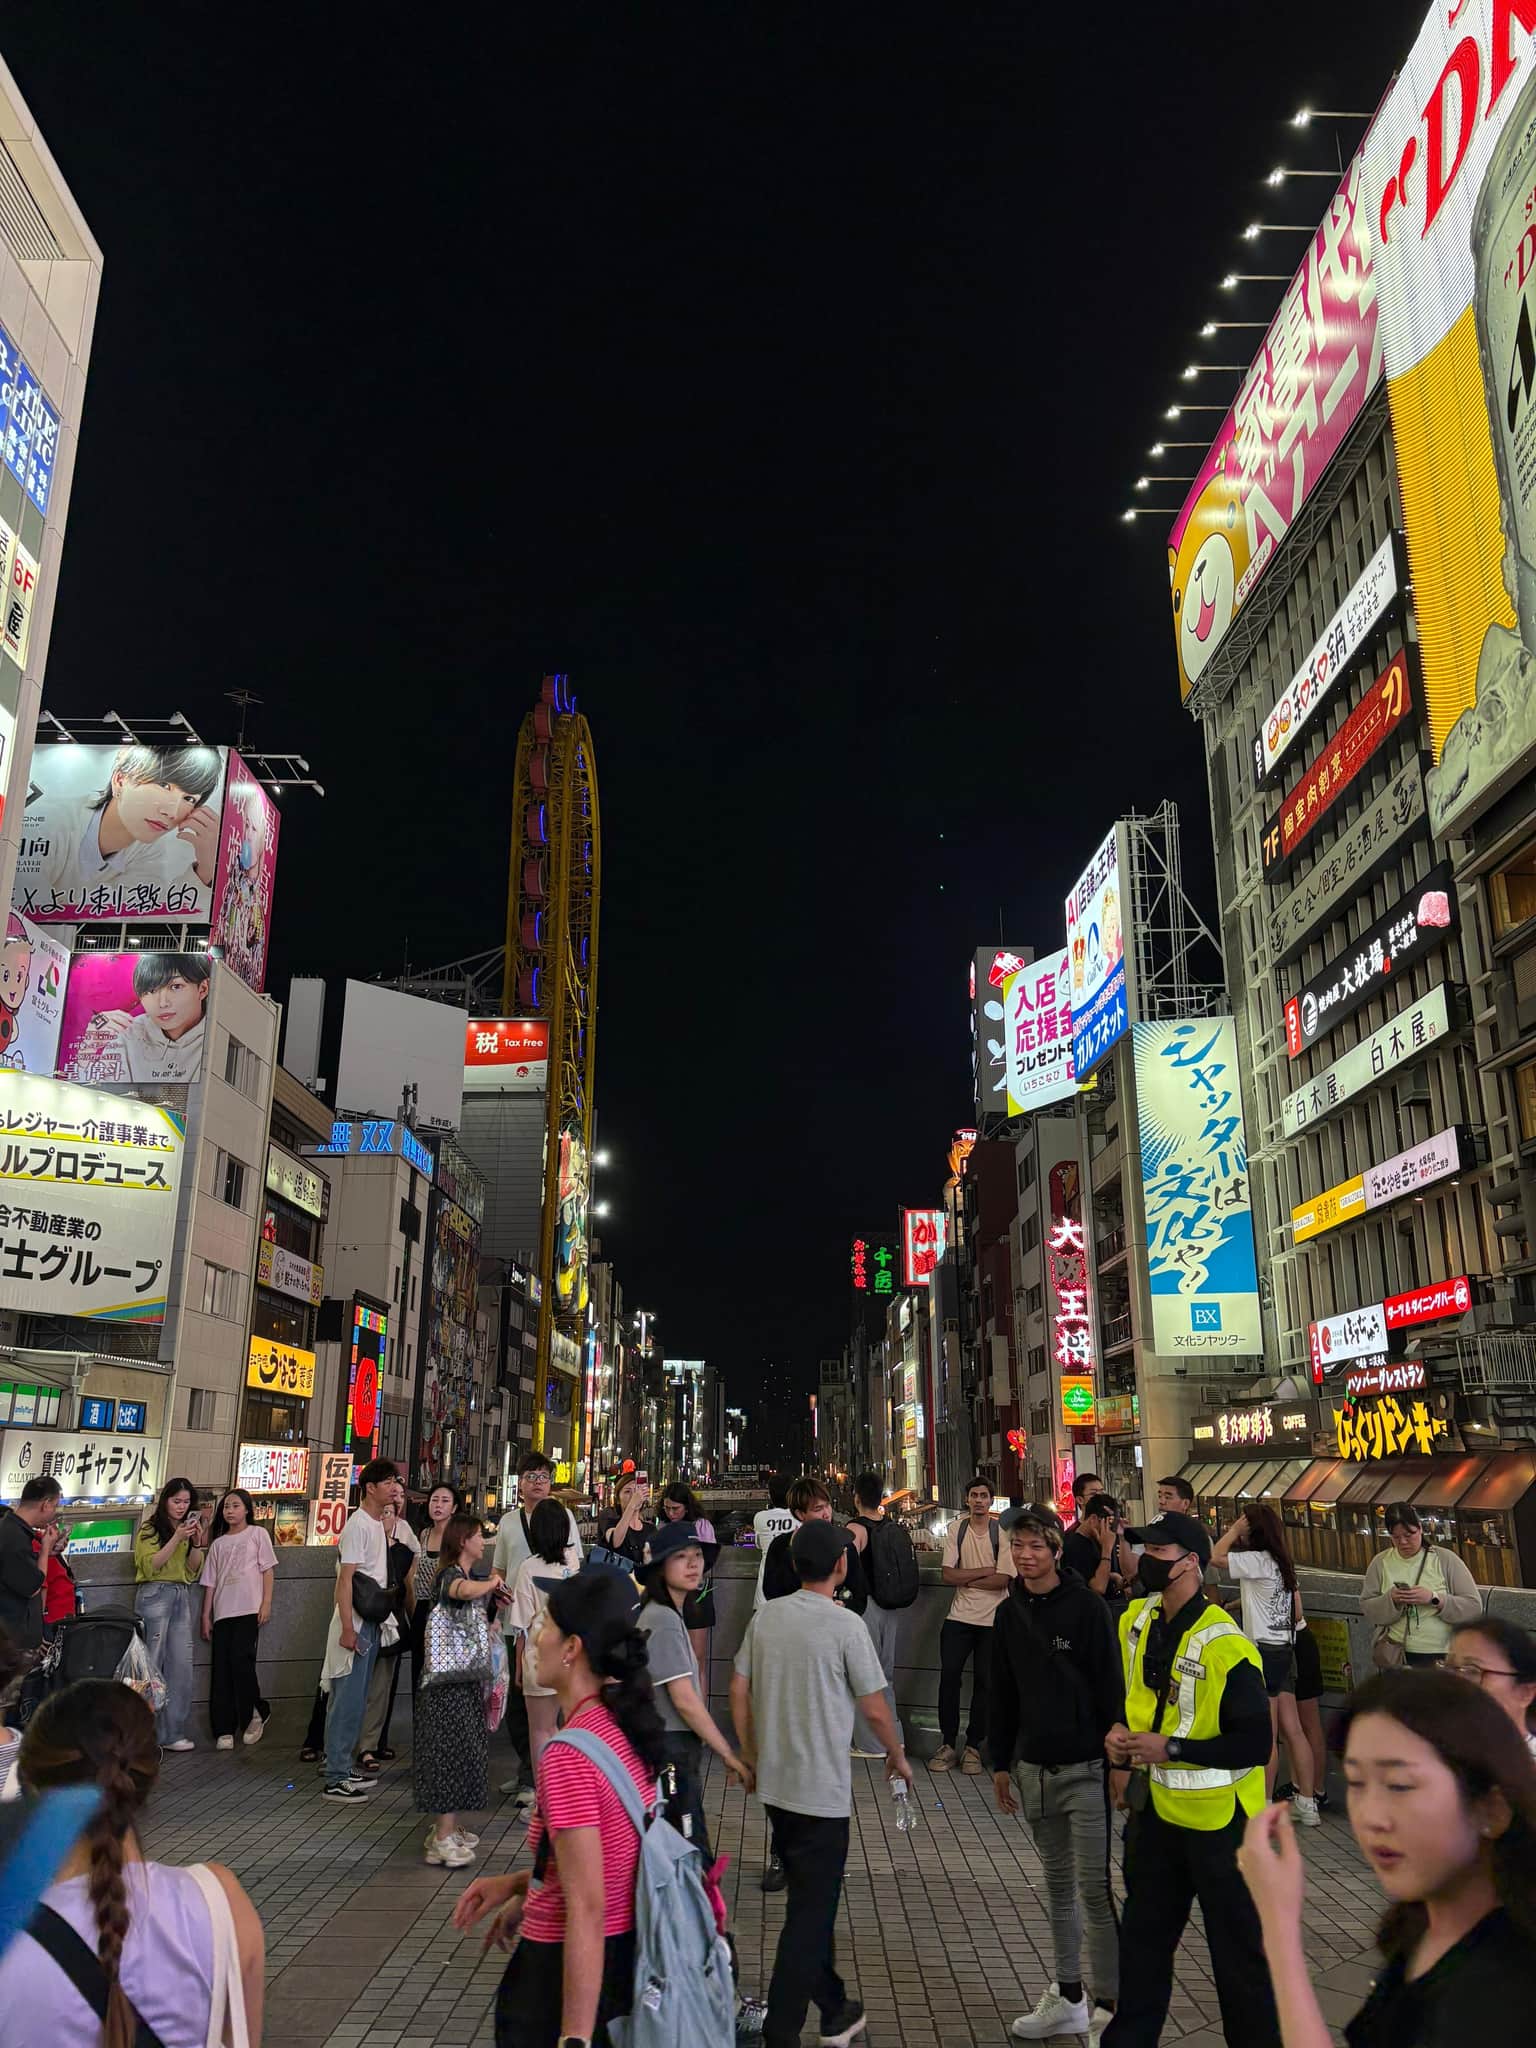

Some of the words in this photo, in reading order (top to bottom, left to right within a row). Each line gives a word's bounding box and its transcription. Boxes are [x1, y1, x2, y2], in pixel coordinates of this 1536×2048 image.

[14, 558, 34, 593] 6F
[1347, 553, 1386, 623] しゃぶしゃぶ
[1382, 666, 1402, 725] 刀
[1255, 740, 1262, 778] 8F
[1284, 751, 1343, 840] 個室肉割烹
[1264, 824, 1280, 866] 7F
[1291, 808, 1388, 929] 完全個室居酒屋
[1341, 938, 1384, 1001] 大牧場
[1015, 972, 1056, 1020] 入店
[475, 1032, 498, 1054] 税
[504, 1039, 520, 1047] Tax
[523, 1038, 544, 1047] Free
[1076, 999, 1124, 1072] ガルフネット
[1288, 1005, 1298, 1051] 5F
[1371, 1010, 1428, 1075] 白木屋
[1296, 1073, 1339, 1126] 白木屋
[0, 1237, 163, 1293] 士グループ
[874, 1247, 892, 1289] 千房
[1195, 1309, 1217, 1324] BX
[1312, 1332, 1319, 1375] 2F
[1347, 1364, 1424, 1393] ハンバーグレストラン
[1283, 1414, 1307, 1430] COFFEE
[1333, 1395, 1449, 1461] びっくりドンキー
[41, 1443, 150, 1486] 賃貸のギャラント
[322, 1457, 349, 1501] 伝串
[316, 1502, 346, 1535] 50
